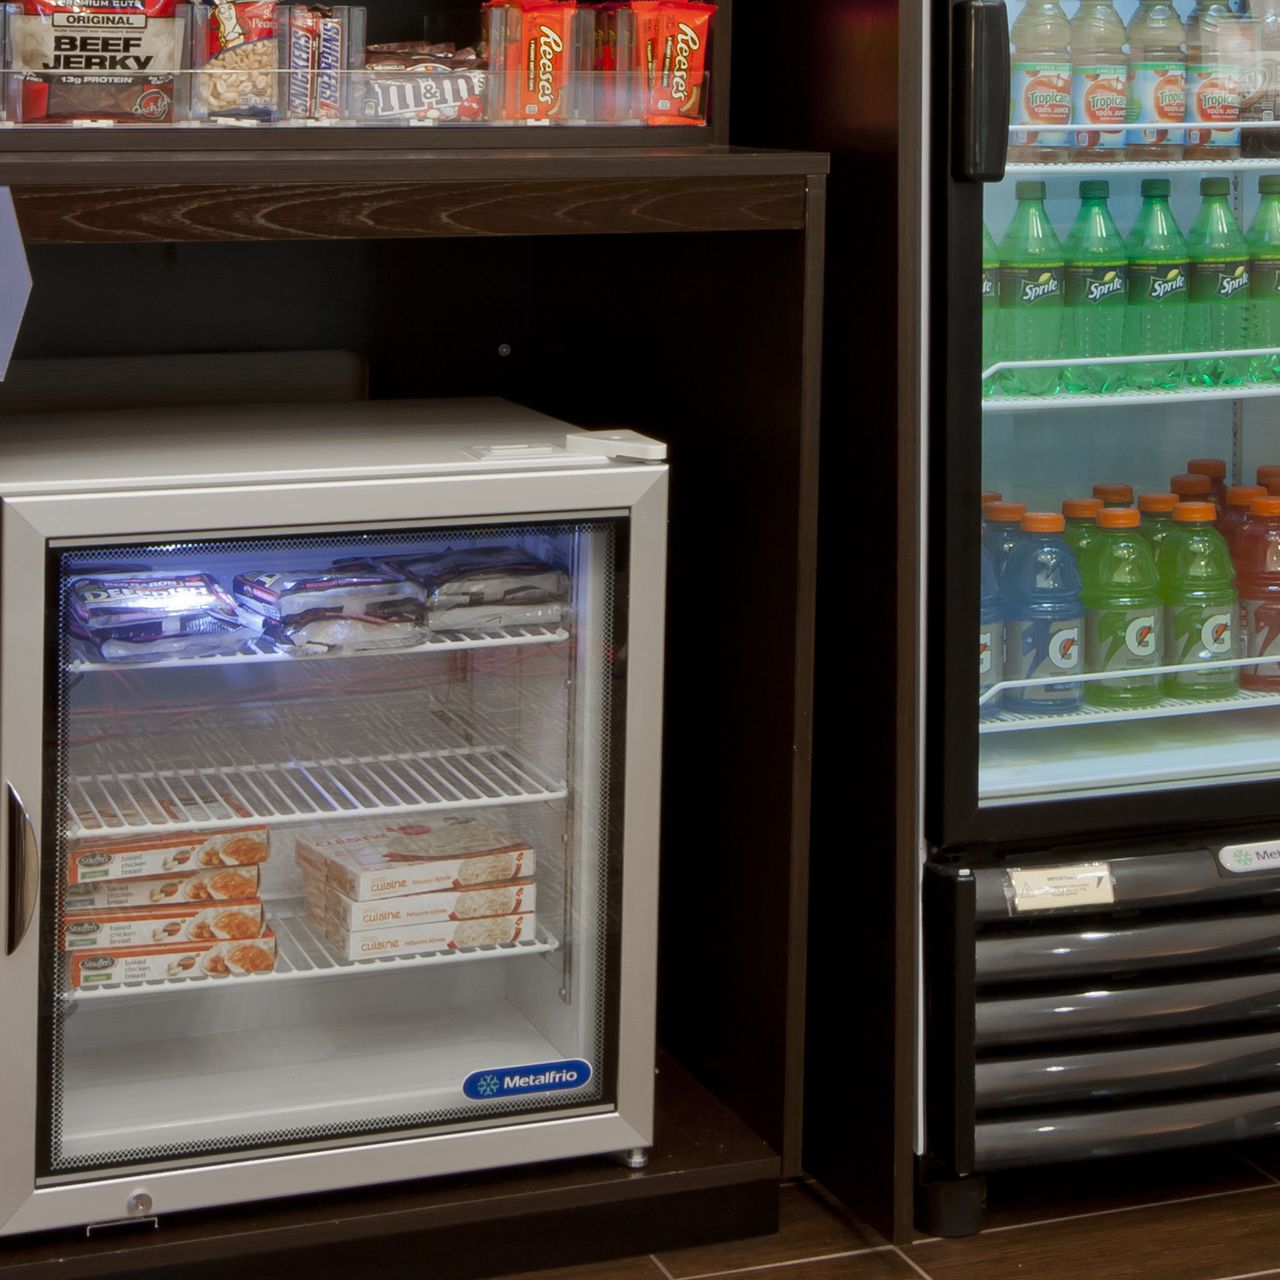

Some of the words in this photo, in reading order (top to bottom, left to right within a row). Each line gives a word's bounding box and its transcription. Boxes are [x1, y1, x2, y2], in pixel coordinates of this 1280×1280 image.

[61, 0, 109, 7] PREMIUM
[66, 15, 134, 26] ORIGINAL
[54, 35, 142, 53] BEEF
[42, 55, 154, 70] JERKY
[290, 29, 311, 113] SNICKERS
[60, 76, 81, 84] 13g
[83, 76, 132, 84] PROTEIN
[1023, 277, 1058, 301] Sprite
[1151, 275, 1185, 298] Sprite
[1125, 616, 1155, 657] G
[1201, 614, 1231, 653] G
[1048, 627, 1079, 669] G
[370, 880, 407, 892] cuisine
[362, 911, 401, 924] cuisine
[360, 939, 400, 952] cuisine
[503, 1069, 578, 1089] Metalfrio
